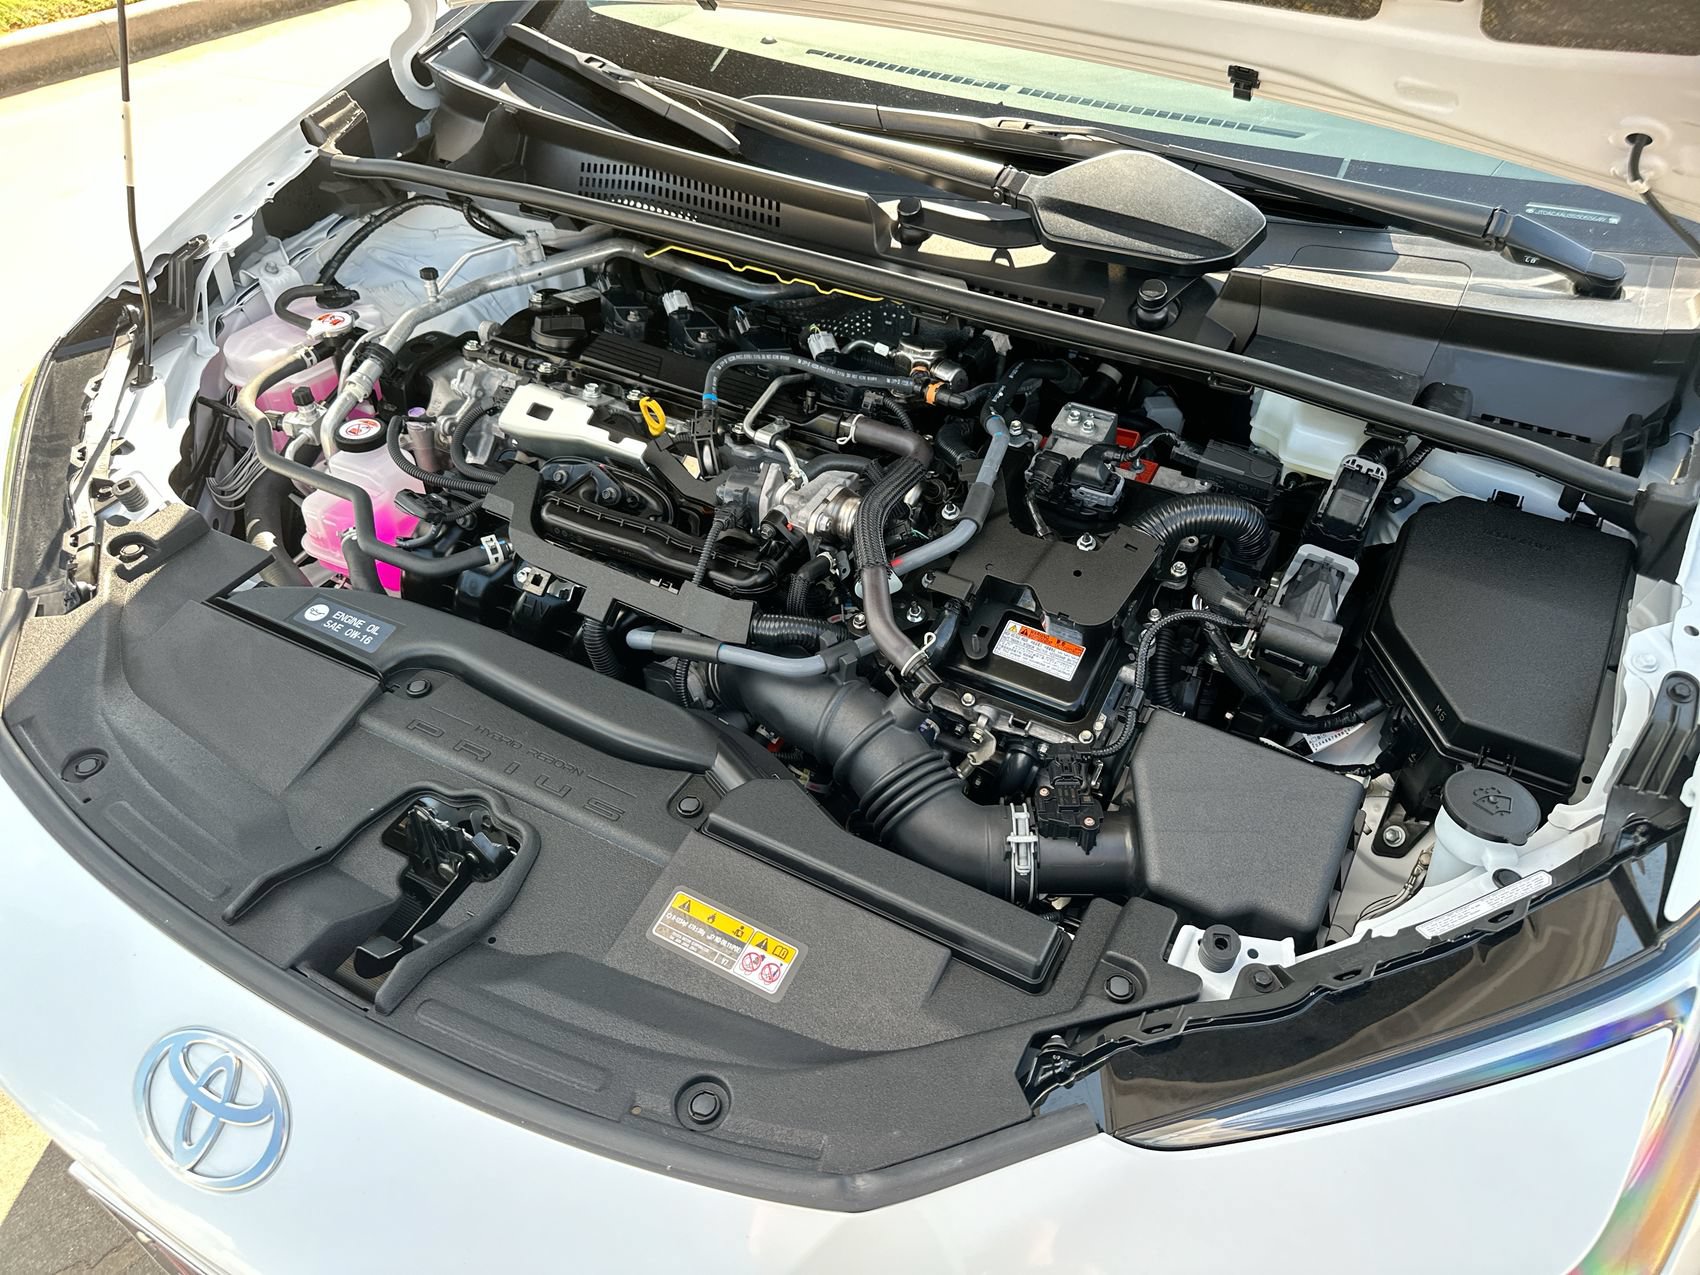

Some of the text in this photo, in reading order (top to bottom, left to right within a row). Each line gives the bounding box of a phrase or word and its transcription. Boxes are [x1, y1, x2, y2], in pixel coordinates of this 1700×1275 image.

[323, 620, 374, 645] SAE 0W-16
[332, 610, 381, 636] ENGINE OIL
[406, 718, 626, 822] PRIUS
[475, 725, 585, 777] HYBRID REBORN
